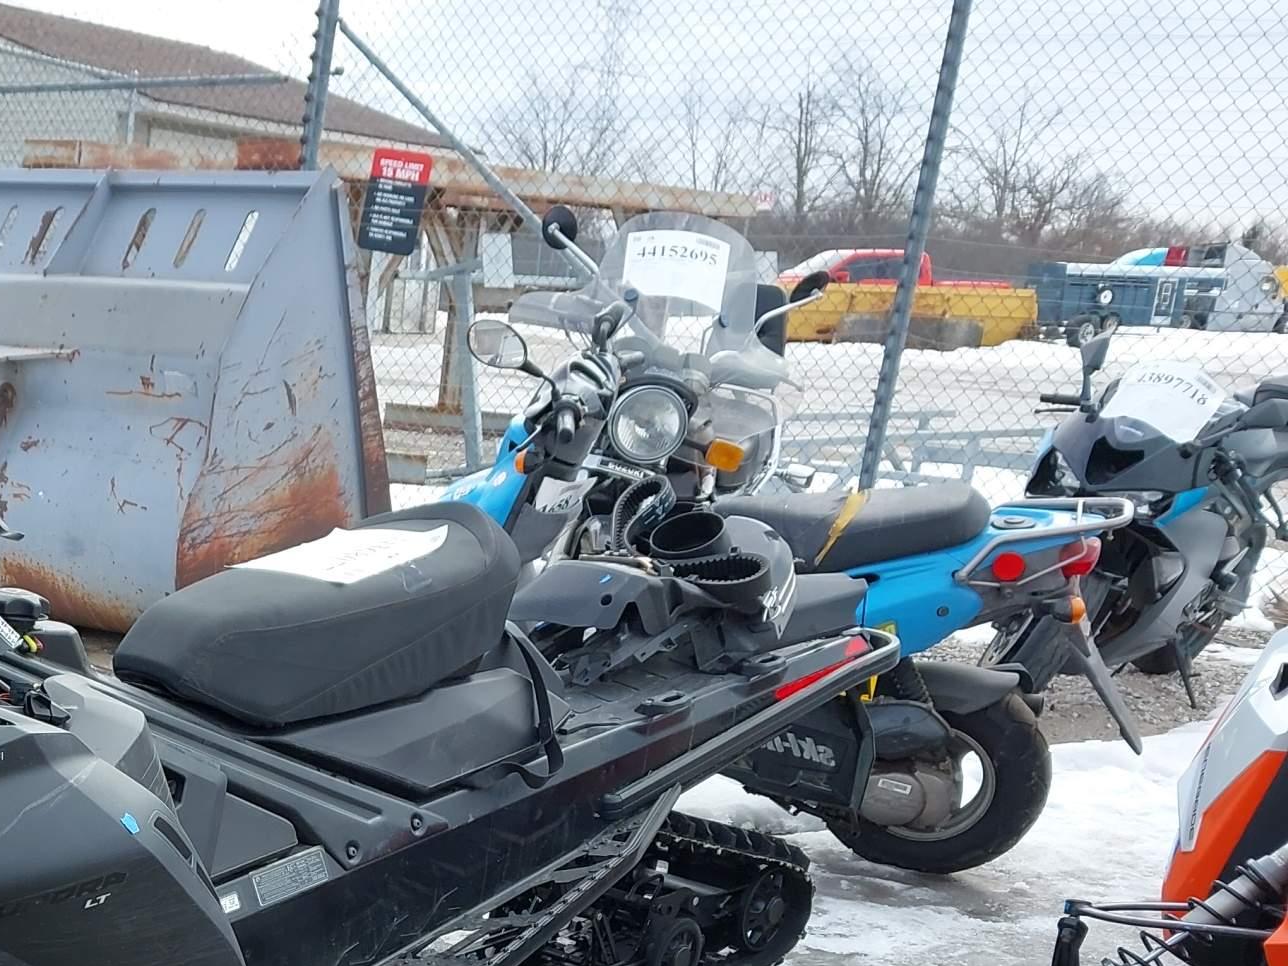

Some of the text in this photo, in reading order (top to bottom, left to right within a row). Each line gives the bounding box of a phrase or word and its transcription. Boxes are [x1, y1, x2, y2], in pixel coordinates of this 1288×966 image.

[394, 168, 421, 182] MPH
[636, 245, 717, 265] 44152695
[608, 461, 644, 479] SUZUKI
[83, 892, 112, 910] LT
